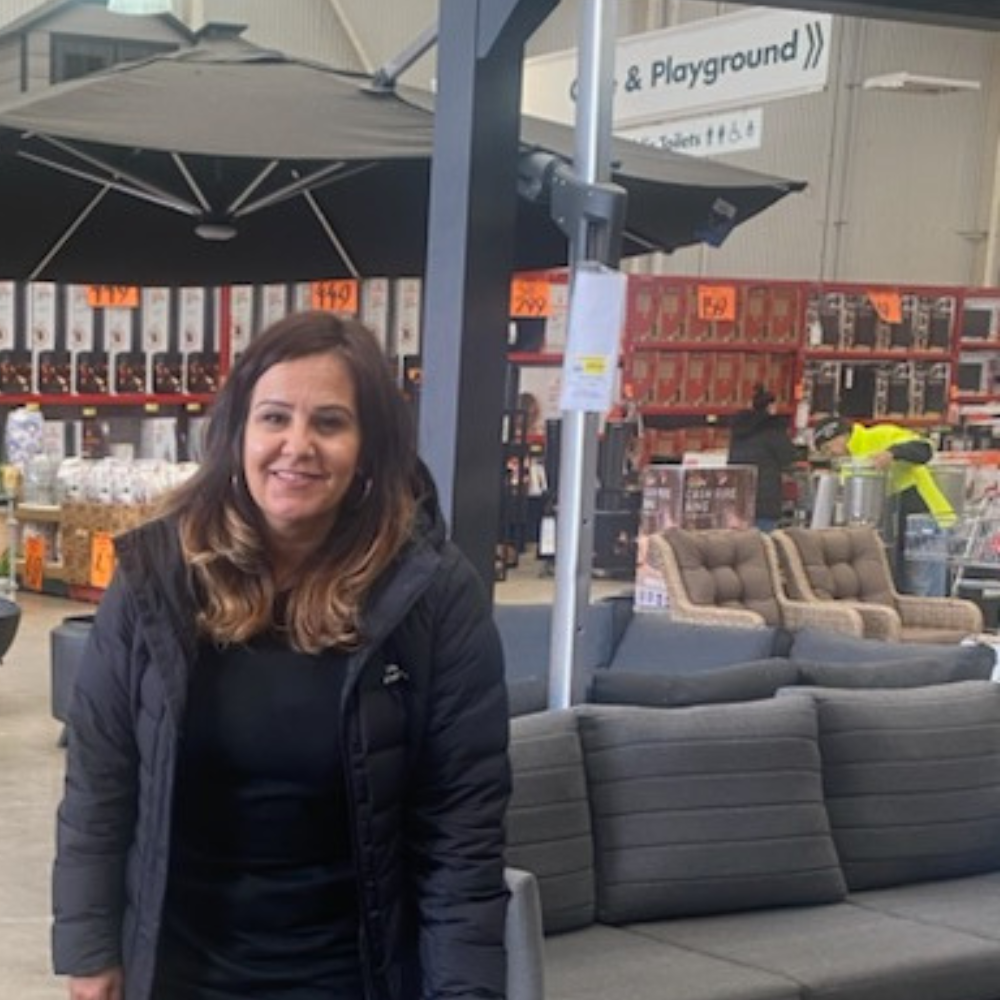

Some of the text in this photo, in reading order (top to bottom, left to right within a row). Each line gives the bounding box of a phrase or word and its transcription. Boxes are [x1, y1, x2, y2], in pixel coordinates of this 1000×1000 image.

[624, 65, 642, 92] &
[651, 28, 798, 89] Playground
[658, 132, 701, 148] Toilets
